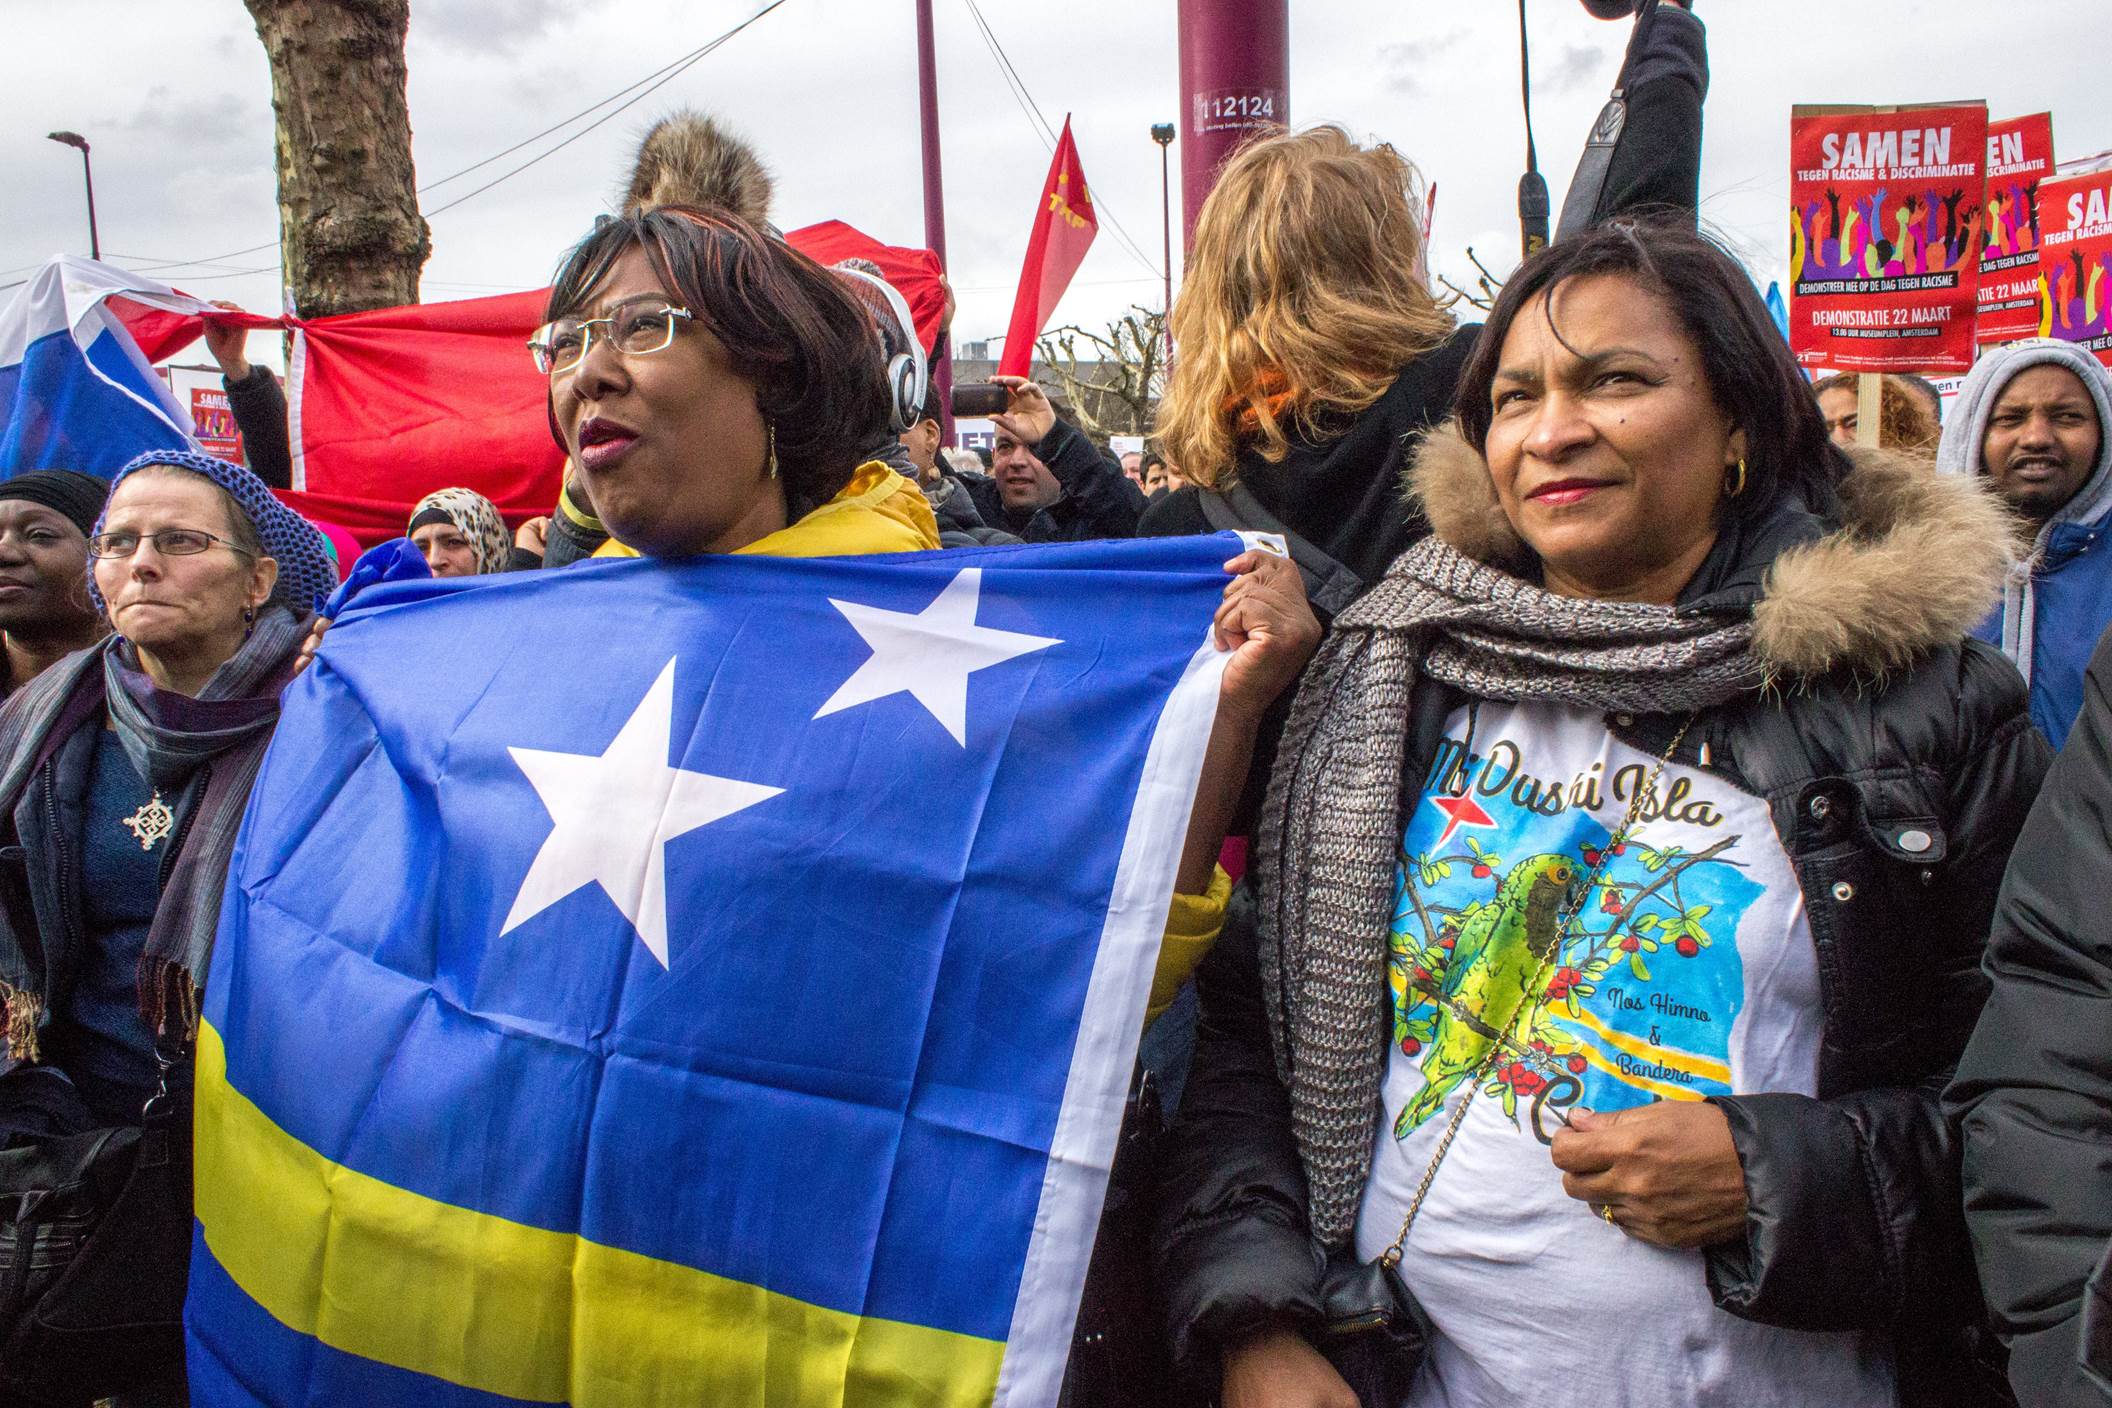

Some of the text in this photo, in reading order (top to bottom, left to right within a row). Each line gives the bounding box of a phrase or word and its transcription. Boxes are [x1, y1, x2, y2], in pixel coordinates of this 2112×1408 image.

[1822, 127, 1951, 170] SAMEN
[1797, 163, 1976, 182] TEGEN RACISME & DISCRIMINATIE
[2044, 229, 2074, 246] TEGEN
[1983, 261, 1997, 272] DAG
[1997, 256, 2016, 270] TEGEN
[1799, 274, 1953, 295] DEMONSTREER MEE OP DE DAG TEGEN RACISME
[1996, 283, 2010, 300] 22
[1812, 305, 1952, 326] DEMONSTRATIE 22 MAART
[1901, 327, 1940, 337] AMSTERDAM
[2092, 337, 2106, 350] MEE
[1612, 763, 1723, 827] Isla
[1607, 986, 1712, 1023] Nos Himno
[1649, 1025, 1661, 1046] &
[1615, 1052, 1694, 1084] Bandera
